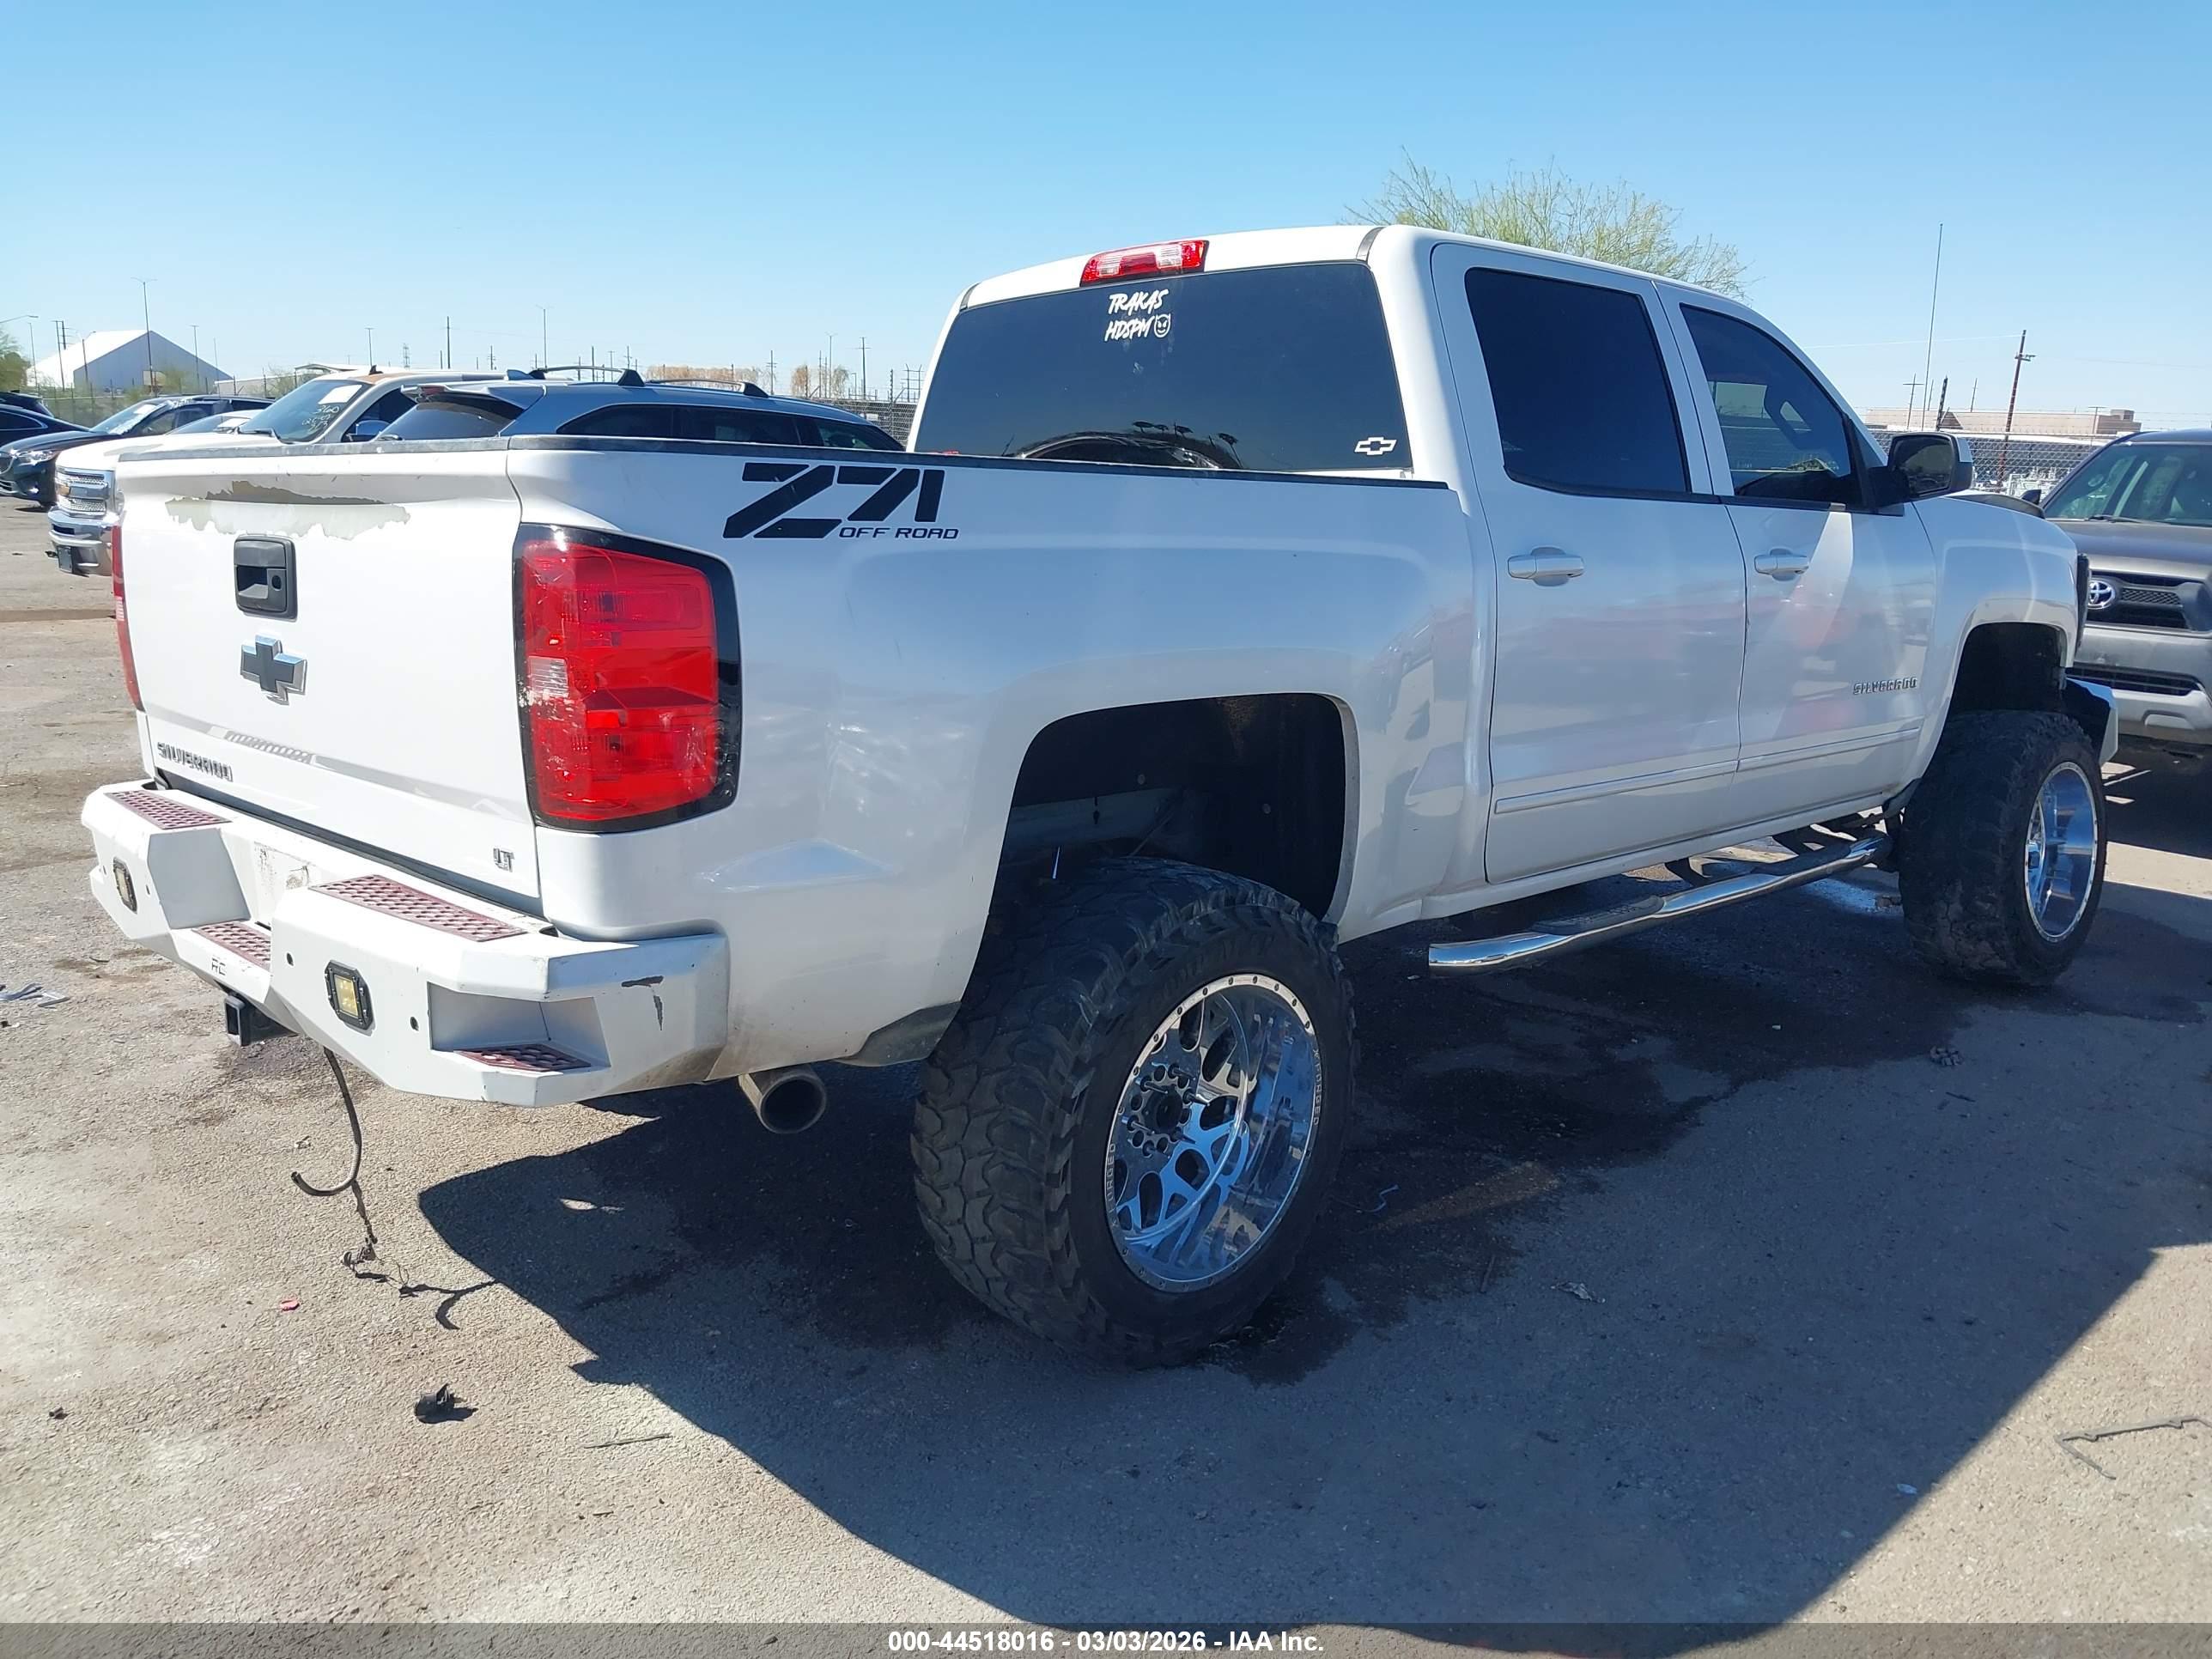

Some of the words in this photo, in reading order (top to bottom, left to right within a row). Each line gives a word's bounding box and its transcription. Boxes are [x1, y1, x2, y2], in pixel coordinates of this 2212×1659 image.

[1108, 289, 1169, 316] TRAKAS
[722, 462, 945, 538] Z71
[839, 526, 890, 539] OFF
[895, 527, 959, 540] ROAD
[1853, 676, 1917, 695] SILVERADO
[157, 741, 234, 782] SILVERADO
[493, 848, 515, 873] LT
